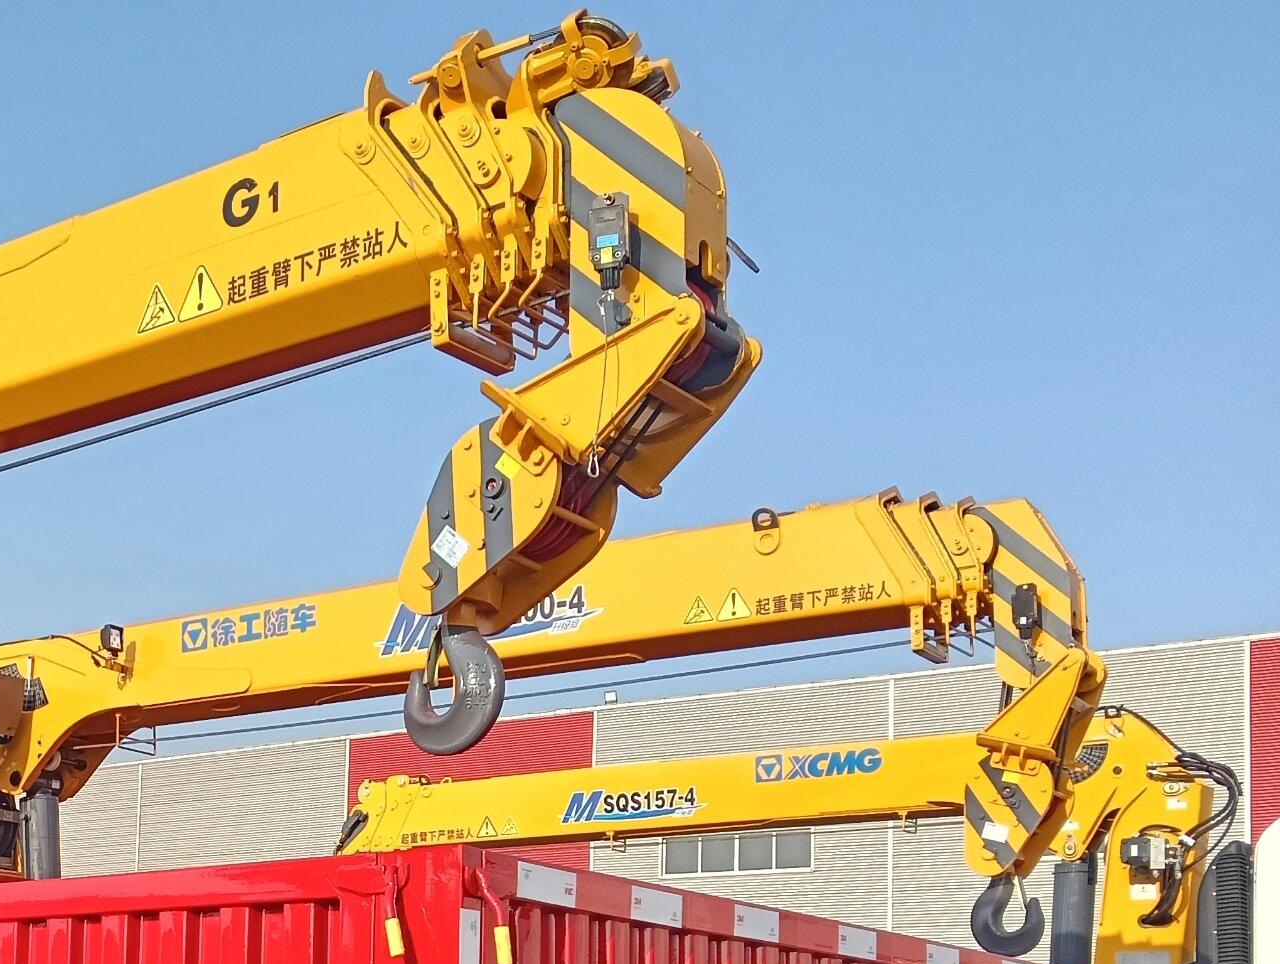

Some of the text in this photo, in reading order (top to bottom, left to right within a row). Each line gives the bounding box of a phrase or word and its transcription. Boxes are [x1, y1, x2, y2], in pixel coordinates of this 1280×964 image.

[227, 220, 408, 306] 起重臂下严禁站人
[755, 580, 891, 616] 起重臂下严禁站人
[211, 603, 317, 647] 徐工随车
[783, 748, 883, 781] XCMG
[562, 787, 696, 823] MSQS157-4
[401, 827, 474, 845] 起重臂下严禁站人
